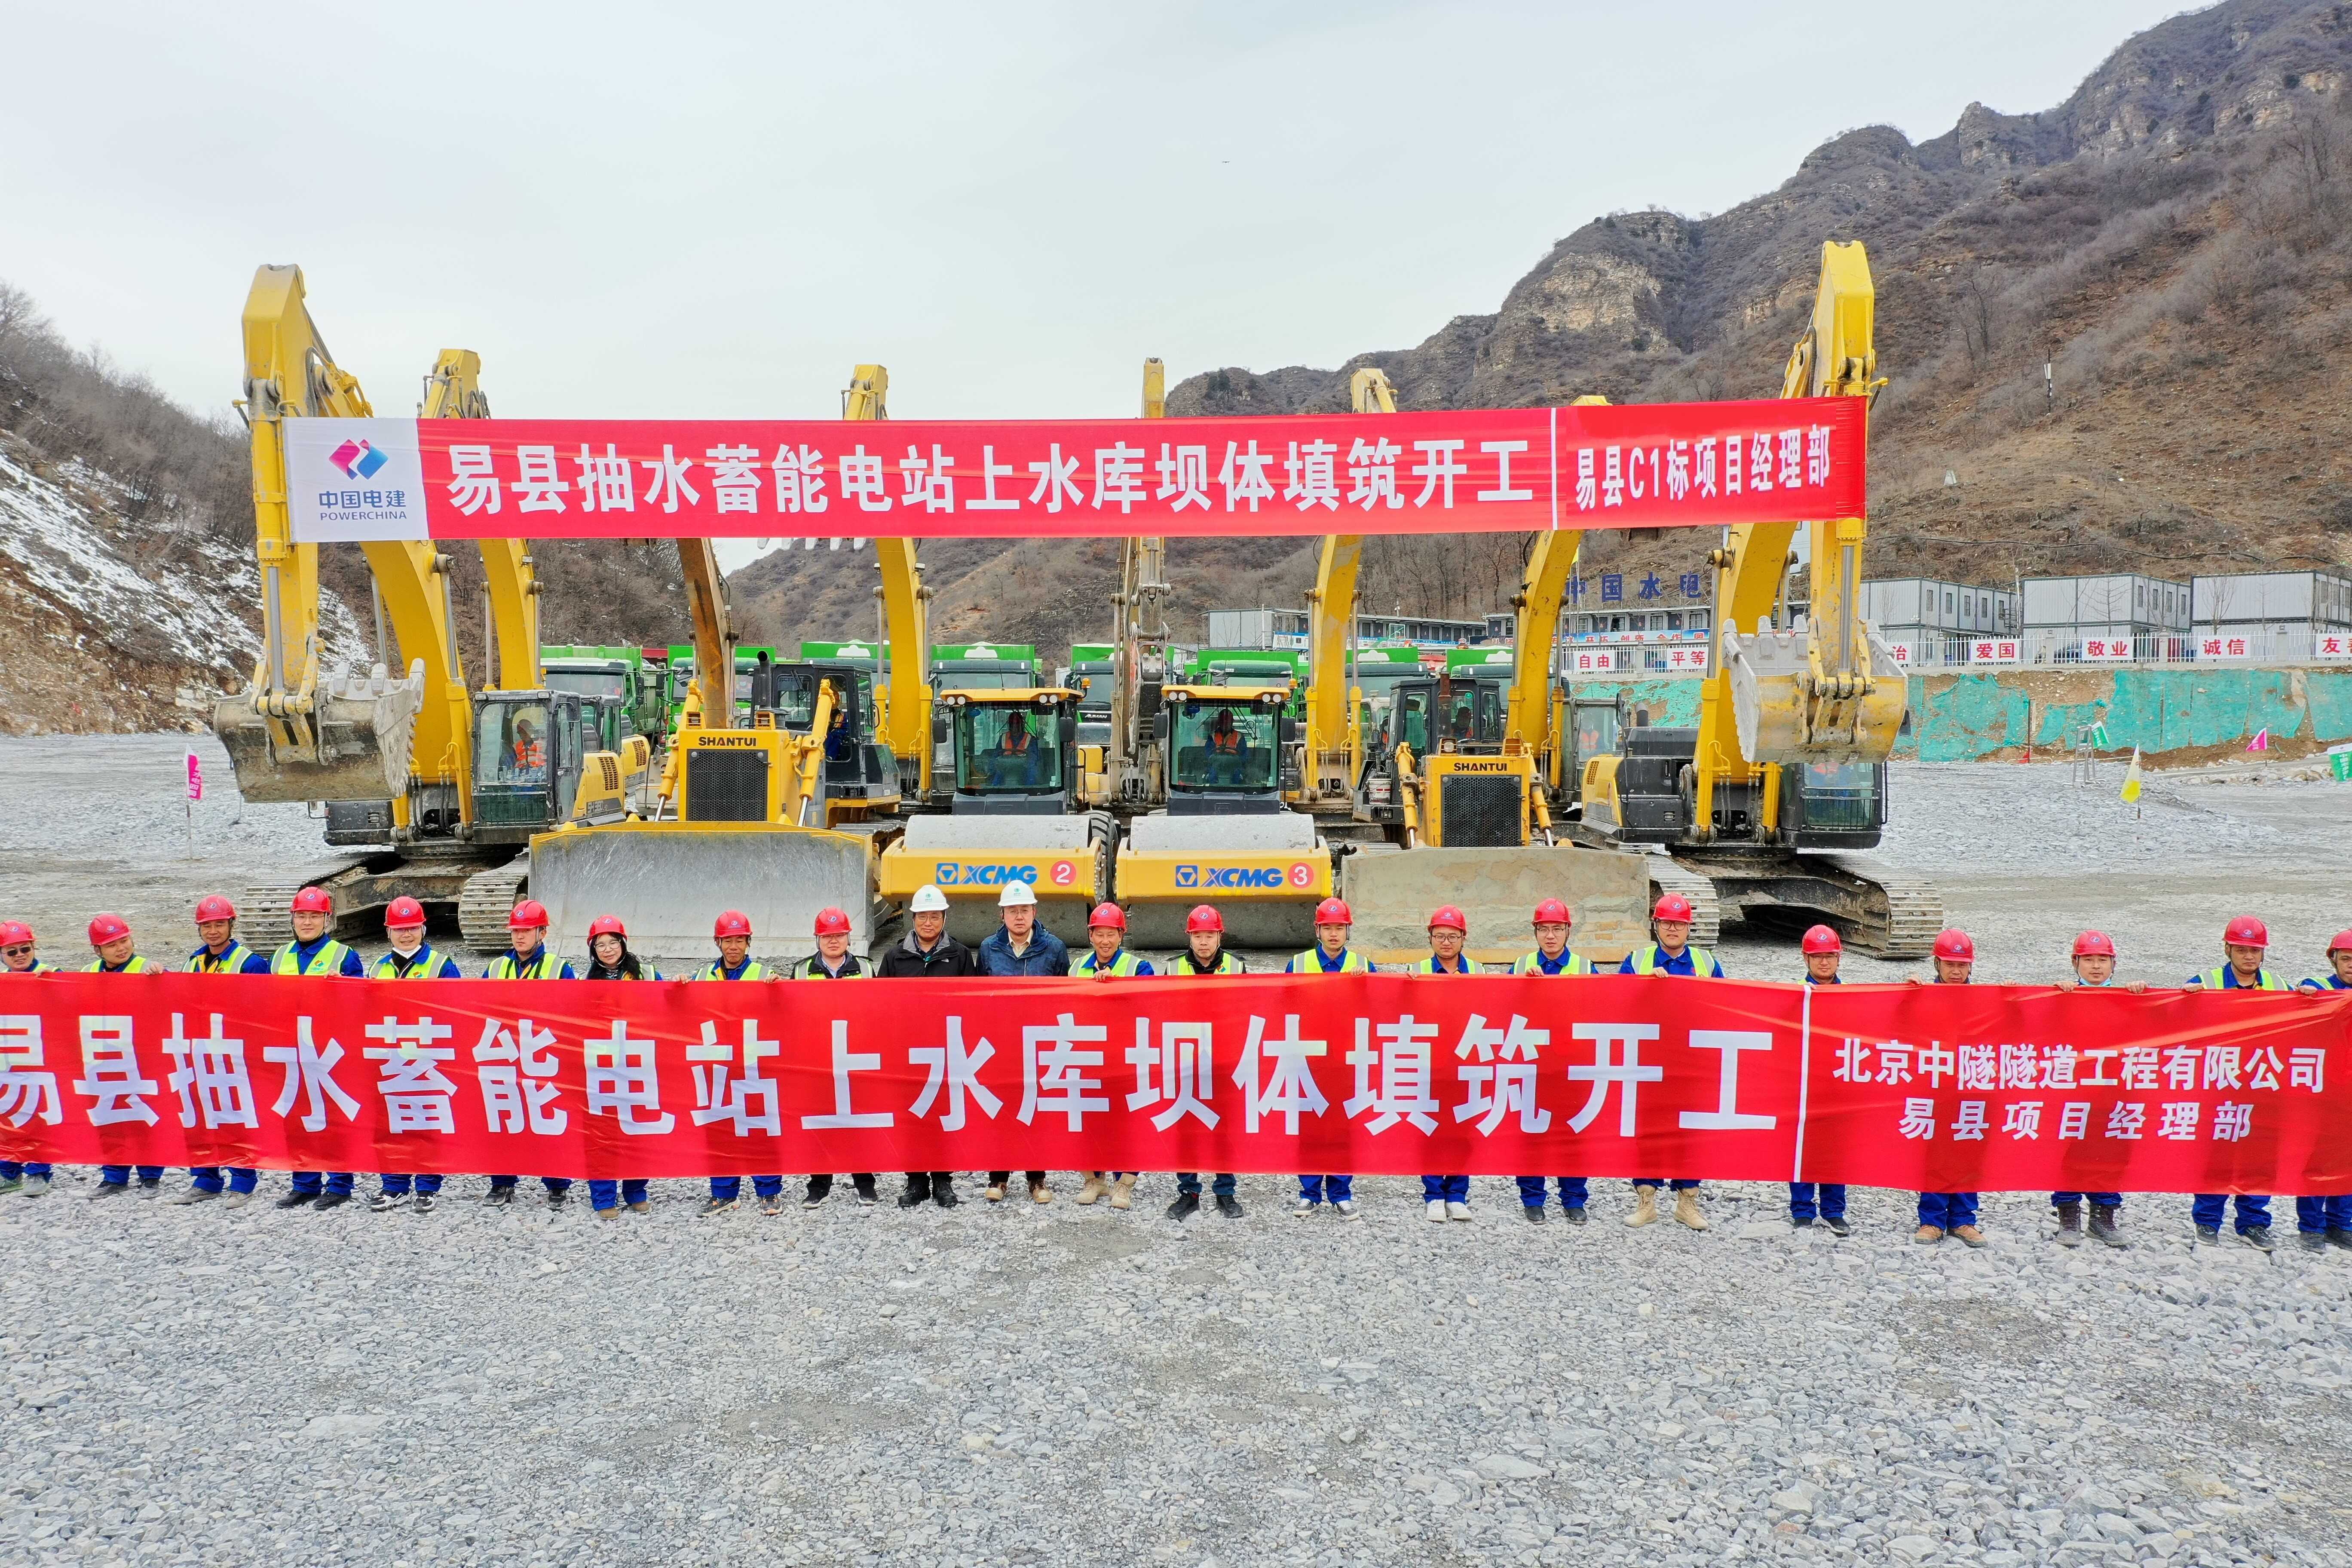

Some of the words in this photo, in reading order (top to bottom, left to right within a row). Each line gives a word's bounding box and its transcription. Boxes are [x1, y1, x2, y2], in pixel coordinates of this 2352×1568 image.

[447, 436, 1533, 516] 易县抽水蓄能电站上水库坝体填筑开工
[1575, 424, 1830, 511] 易县C1标项目经理部
[319, 490, 406, 509] 中国电建
[320, 511, 407, 521] POWERCHINA
[1891, 645, 1907, 661] 治
[1976, 643, 2015, 658] 爱国
[2087, 640, 2128, 656] 敬业
[2203, 639, 2245, 655] 诚信
[1578, 652, 1610, 669] 自由
[1671, 650, 1705, 666] 平等
[698, 736, 756, 747] SHANTUI
[1454, 762, 1507, 772] SHANTUI
[959, 864, 1038, 885] XCMG
[1055, 864, 1071, 884] 2
[1202, 868, 1283, 888] XCMG
[1293, 865, 1308, 886] 3
[0, 1013, 1776, 1137] 易县抽水蓄能电站上水库坝体填筑开工
[1833, 1038, 2326, 1093] 北京中隧隧道工程有限公司
[1899, 1097, 2254, 1142] 易县项目经理部
